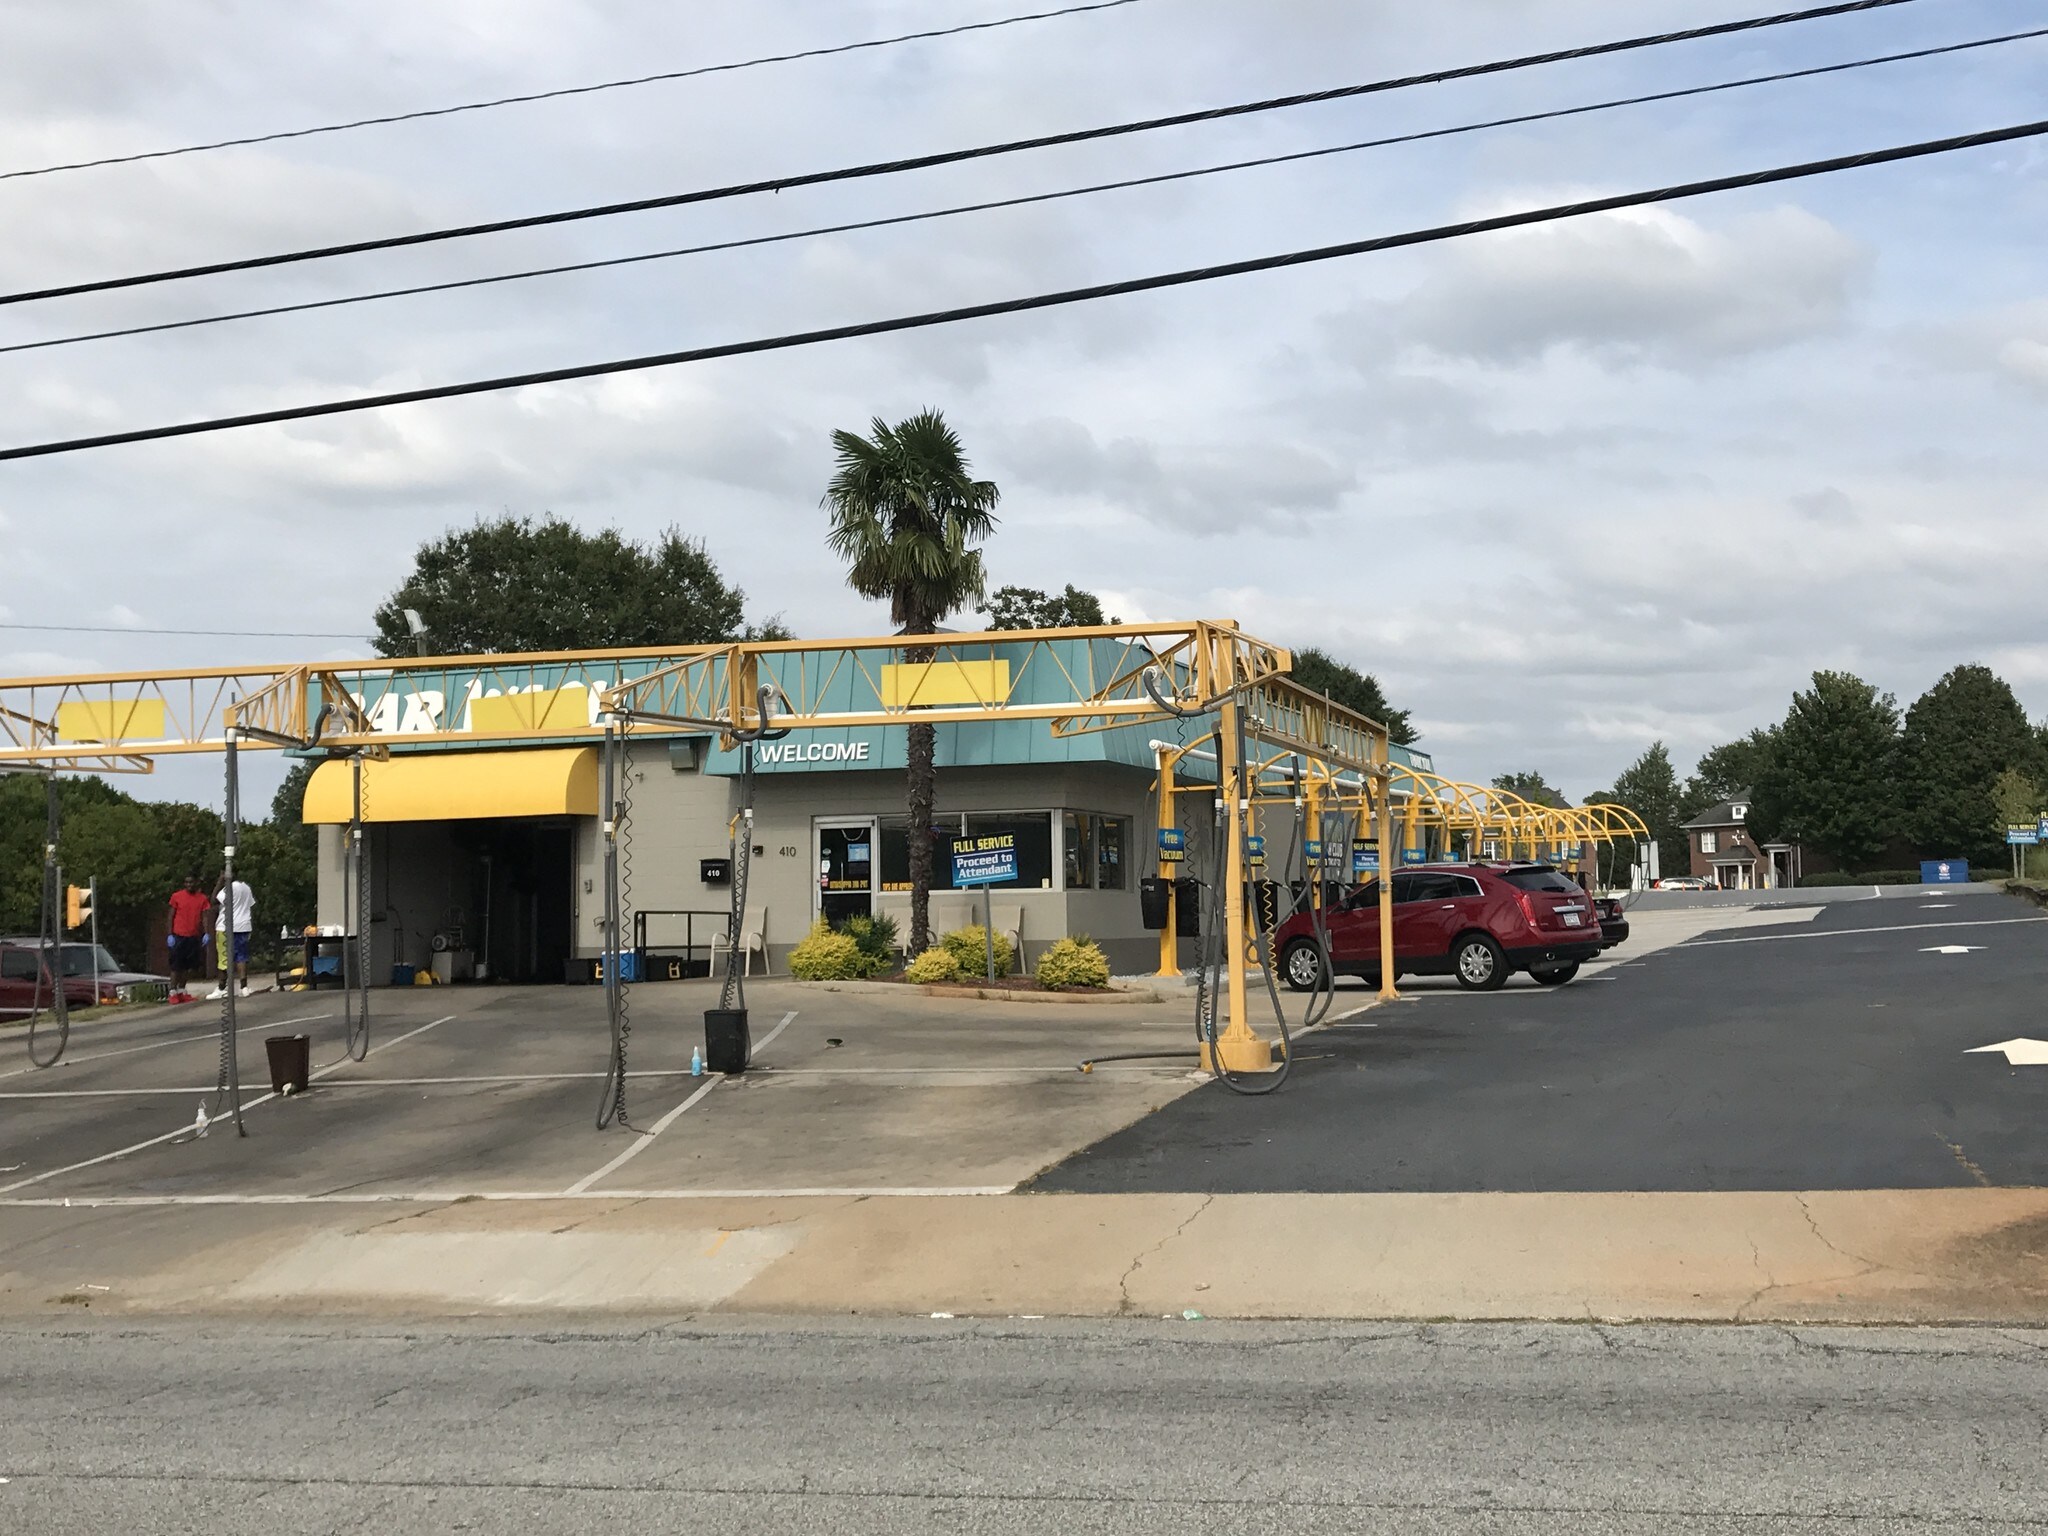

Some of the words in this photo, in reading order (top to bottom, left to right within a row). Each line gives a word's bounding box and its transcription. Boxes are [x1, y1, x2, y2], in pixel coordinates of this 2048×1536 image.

[761, 742, 869, 762] WELCOME
[953, 840, 975, 853] FULL
[977, 835, 1014, 850] SERVICE
[1164, 831, 1178, 844] Free
[779, 846, 797, 857] 410
[1160, 847, 1183, 860] Vacuum
[956, 854, 998, 868] Proceed
[1001, 854, 1013, 862] to
[959, 864, 1012, 878] Attendant
